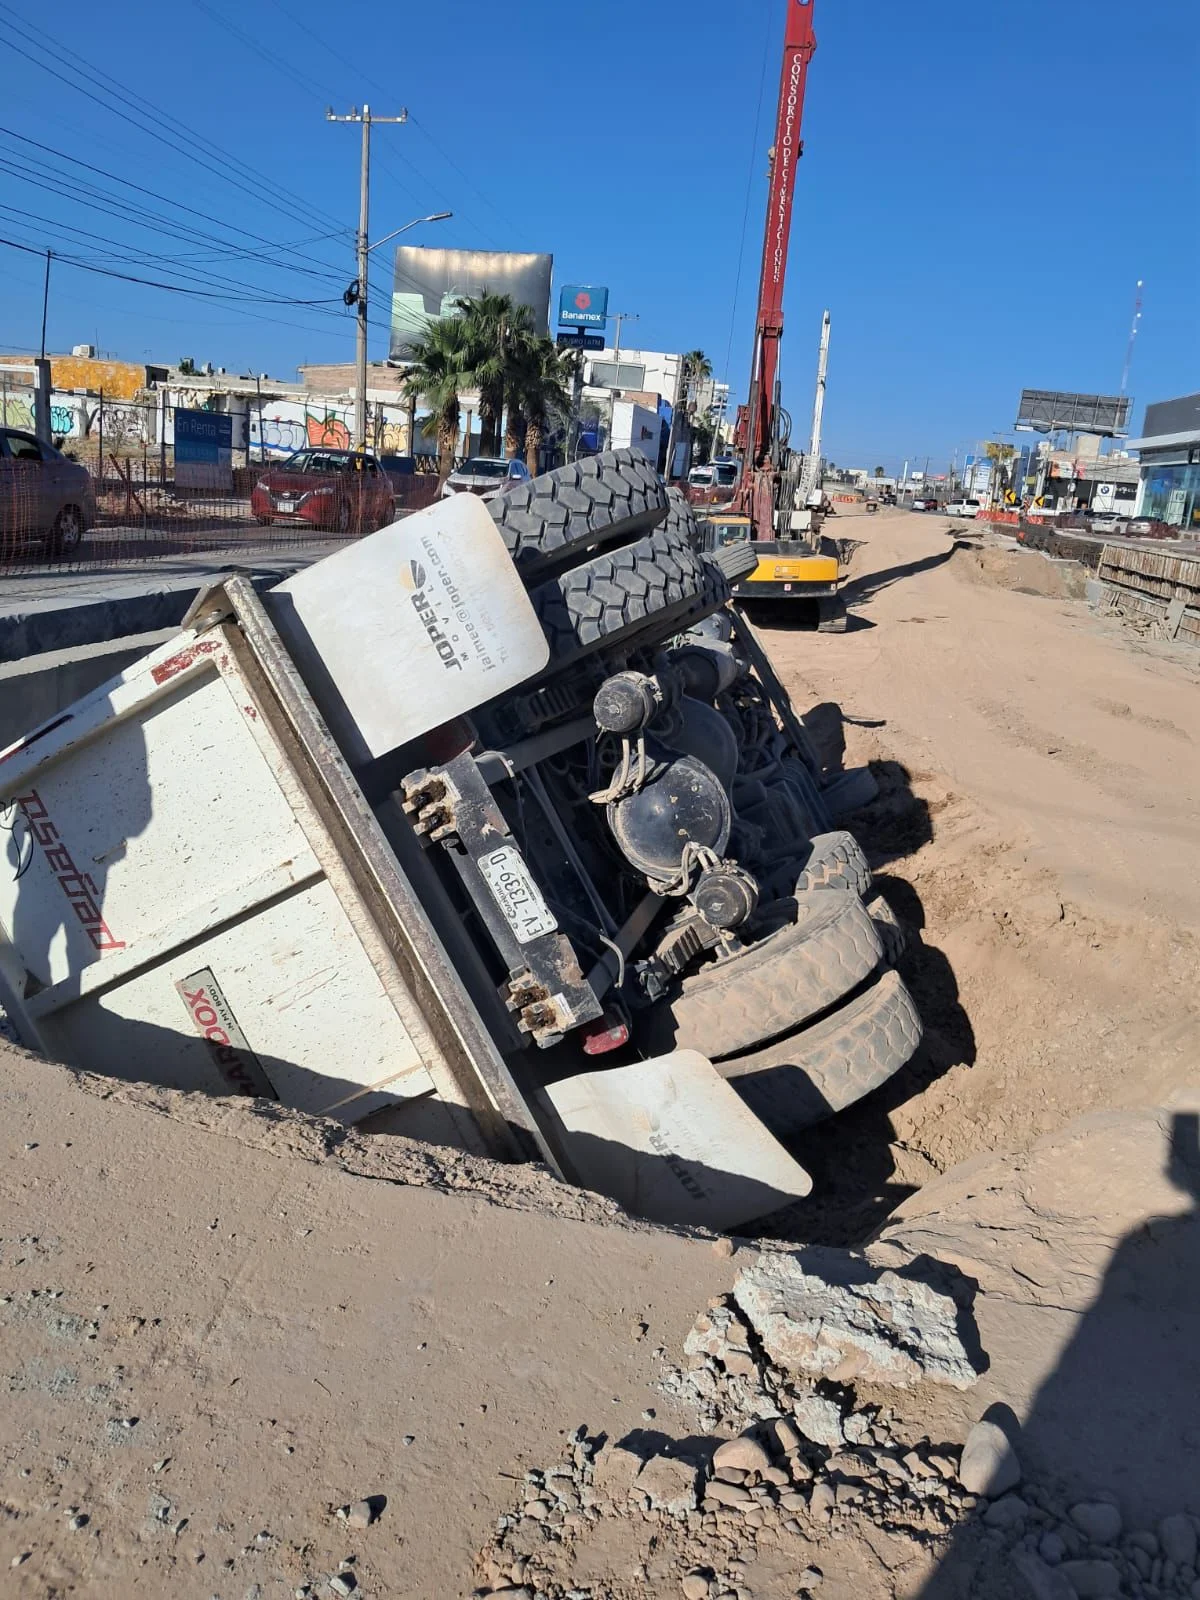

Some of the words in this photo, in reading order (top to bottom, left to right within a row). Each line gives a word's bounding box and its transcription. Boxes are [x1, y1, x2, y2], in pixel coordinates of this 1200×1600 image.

[783, 54, 802, 146] CONSORCIO
[782, 148, 792, 166] DE
[562, 311, 601, 321] Banamex
[177, 416, 189, 432] En
[191, 418, 216, 437] Renta
[410, 591, 463, 671] JOPER
[207, 984, 222, 1007] BODY
